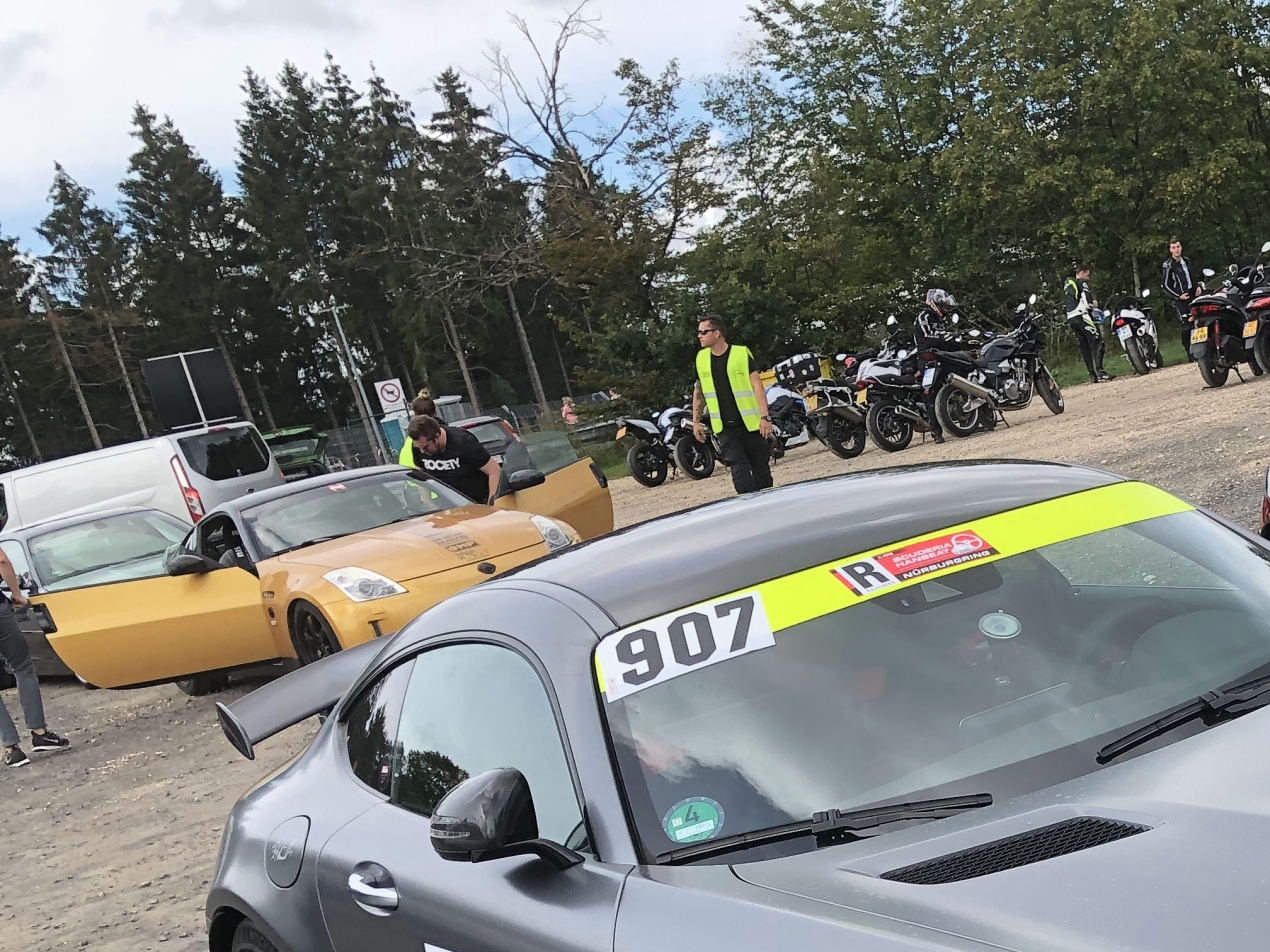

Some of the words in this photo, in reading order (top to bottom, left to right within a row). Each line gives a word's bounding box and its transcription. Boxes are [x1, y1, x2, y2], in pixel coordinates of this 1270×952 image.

[892, 542, 953, 563] SCUDERIA
[895, 548, 951, 569] HANSEAT
[841, 561, 890, 589] R
[615, 595, 755, 686] 907
[685, 804, 700, 822] 4
